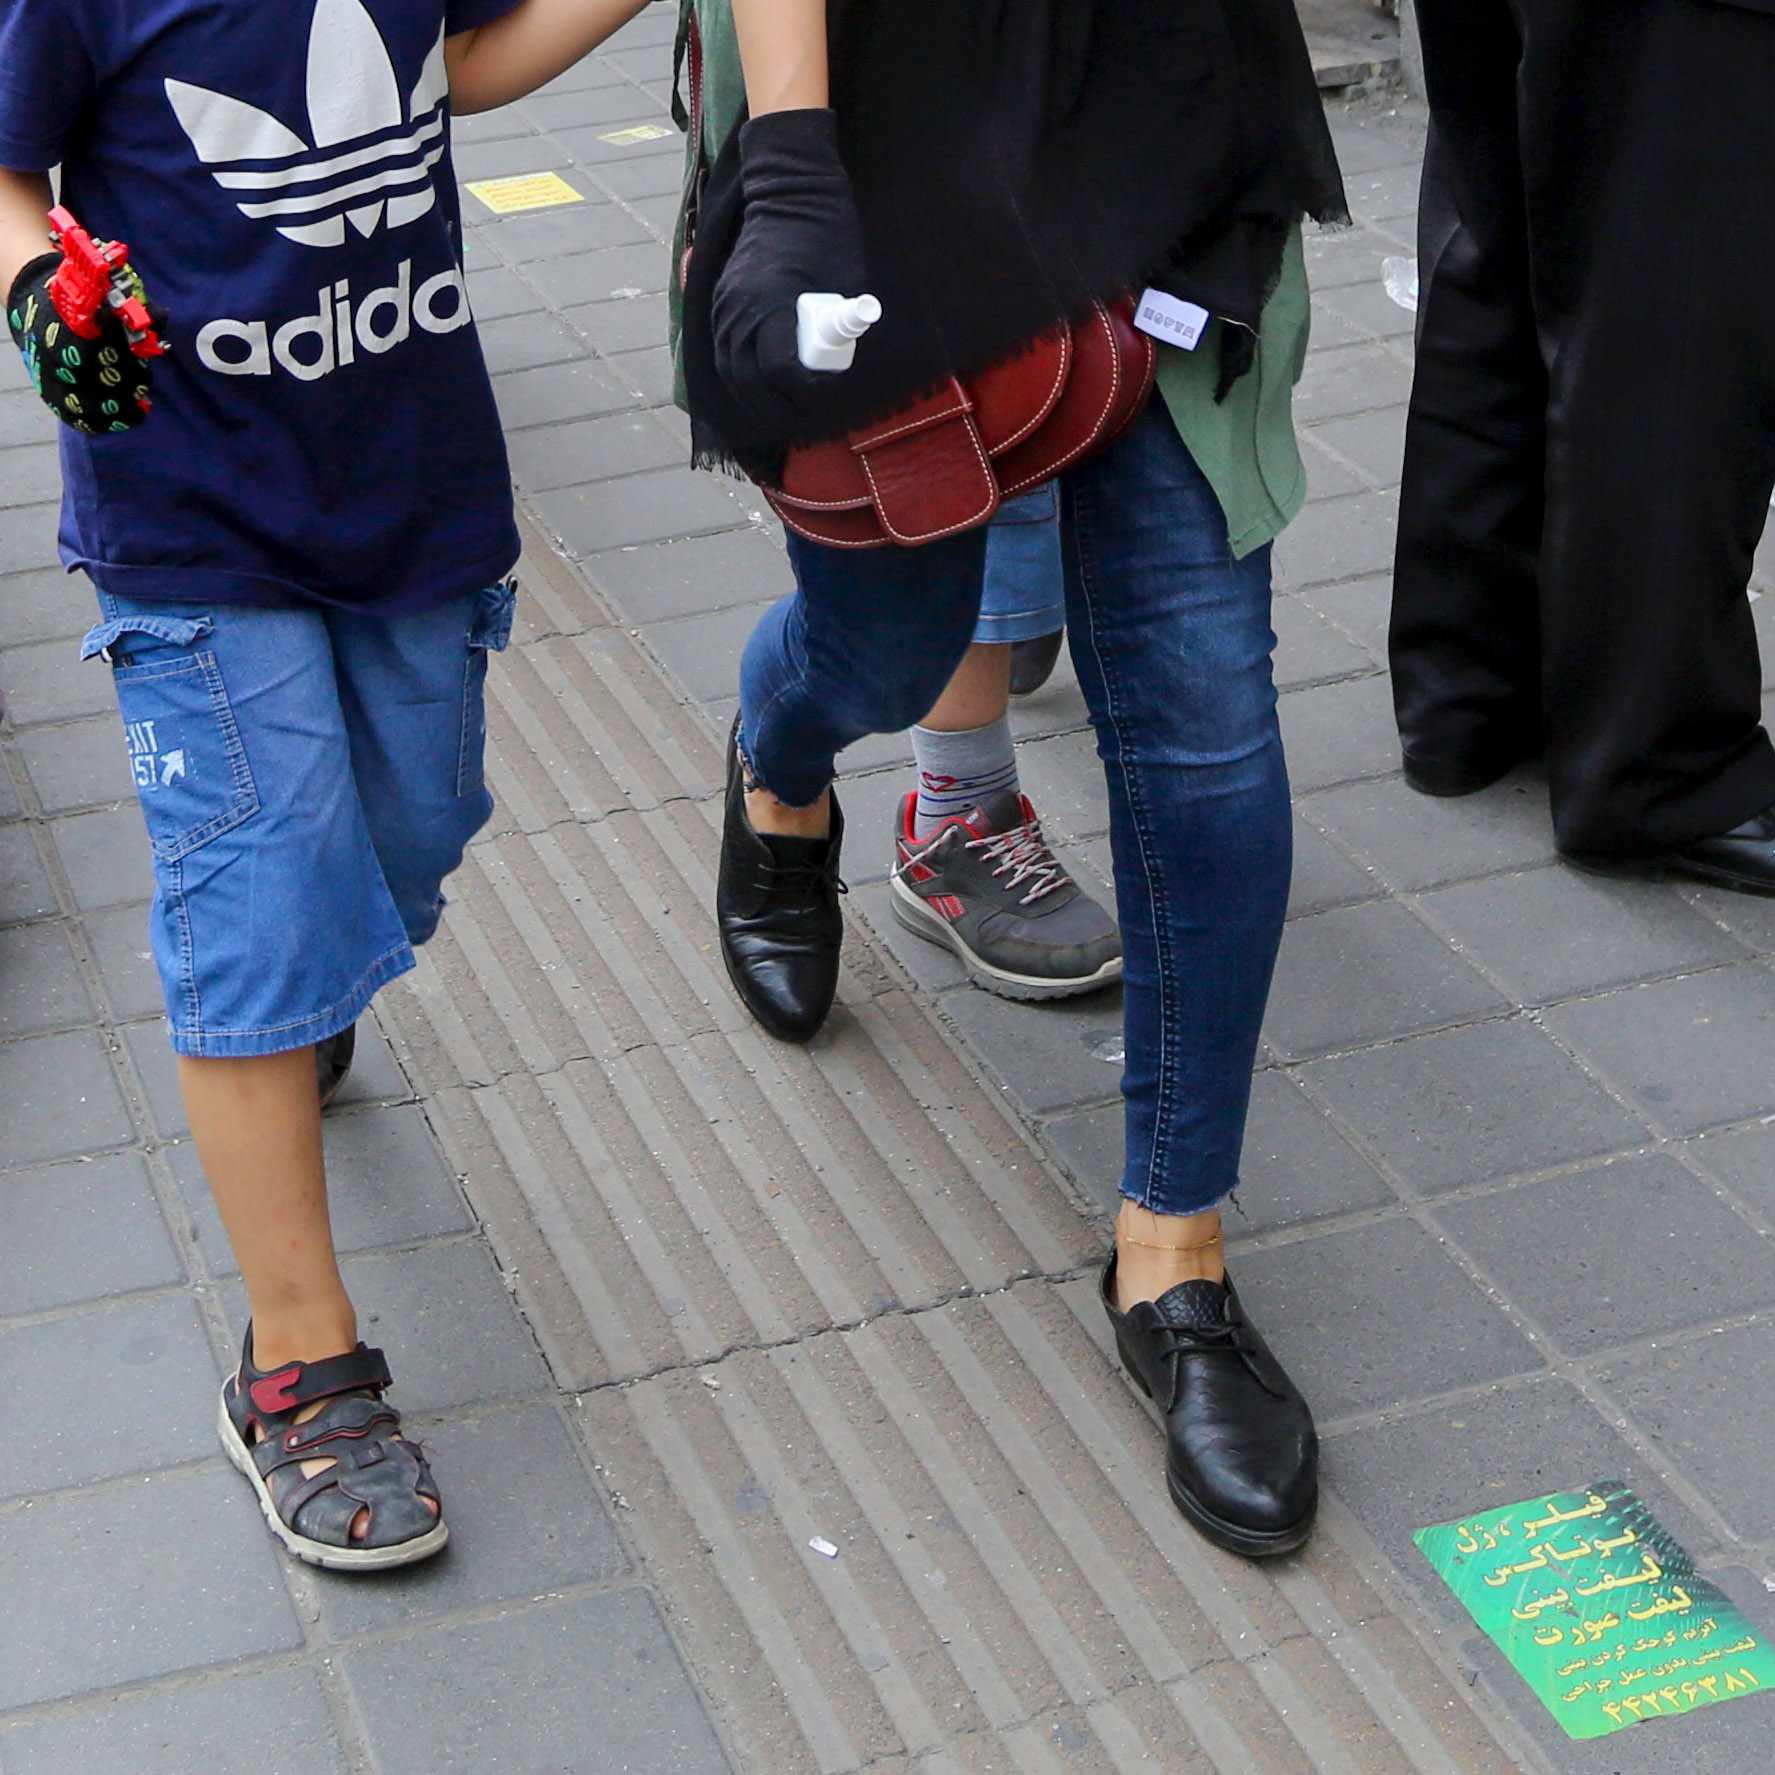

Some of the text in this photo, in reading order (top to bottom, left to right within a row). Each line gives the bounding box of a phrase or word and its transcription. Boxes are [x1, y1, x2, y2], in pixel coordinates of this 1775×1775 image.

[195, 258, 472, 381] adida
[125, 720, 157, 753] XIT
[1456, 1524, 1499, 1554] ژل
[1483, 1526, 1638, 1587] بوتاکس
[1511, 1553, 1664, 1621] لیفت بینی
[1532, 1583, 1693, 1647] لیفت صورت
